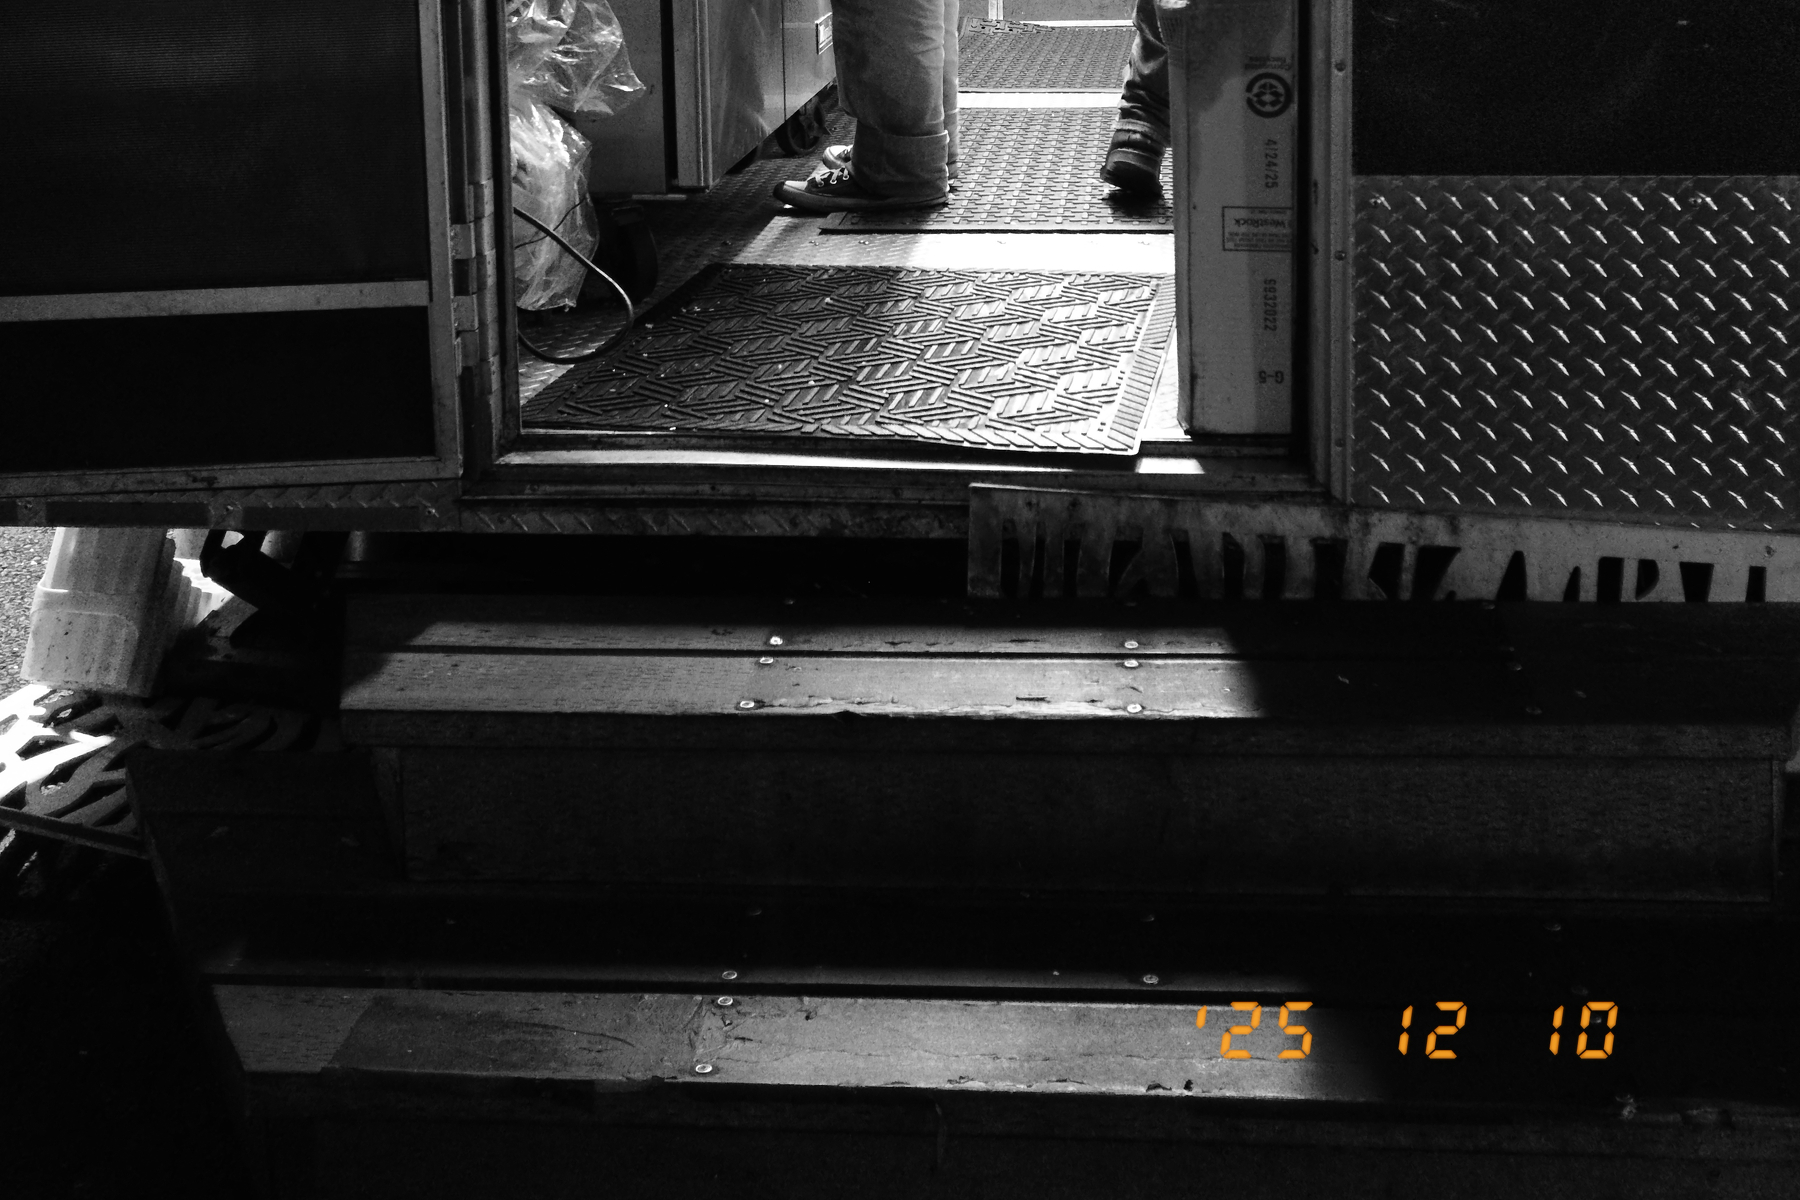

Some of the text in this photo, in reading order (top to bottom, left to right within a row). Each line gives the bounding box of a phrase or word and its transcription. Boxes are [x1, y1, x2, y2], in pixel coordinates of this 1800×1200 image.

[1265, 138, 1278, 189] 4/24/25
[1234, 218, 1286, 228] WestRock
[1259, 370, 1284, 384] G-5
